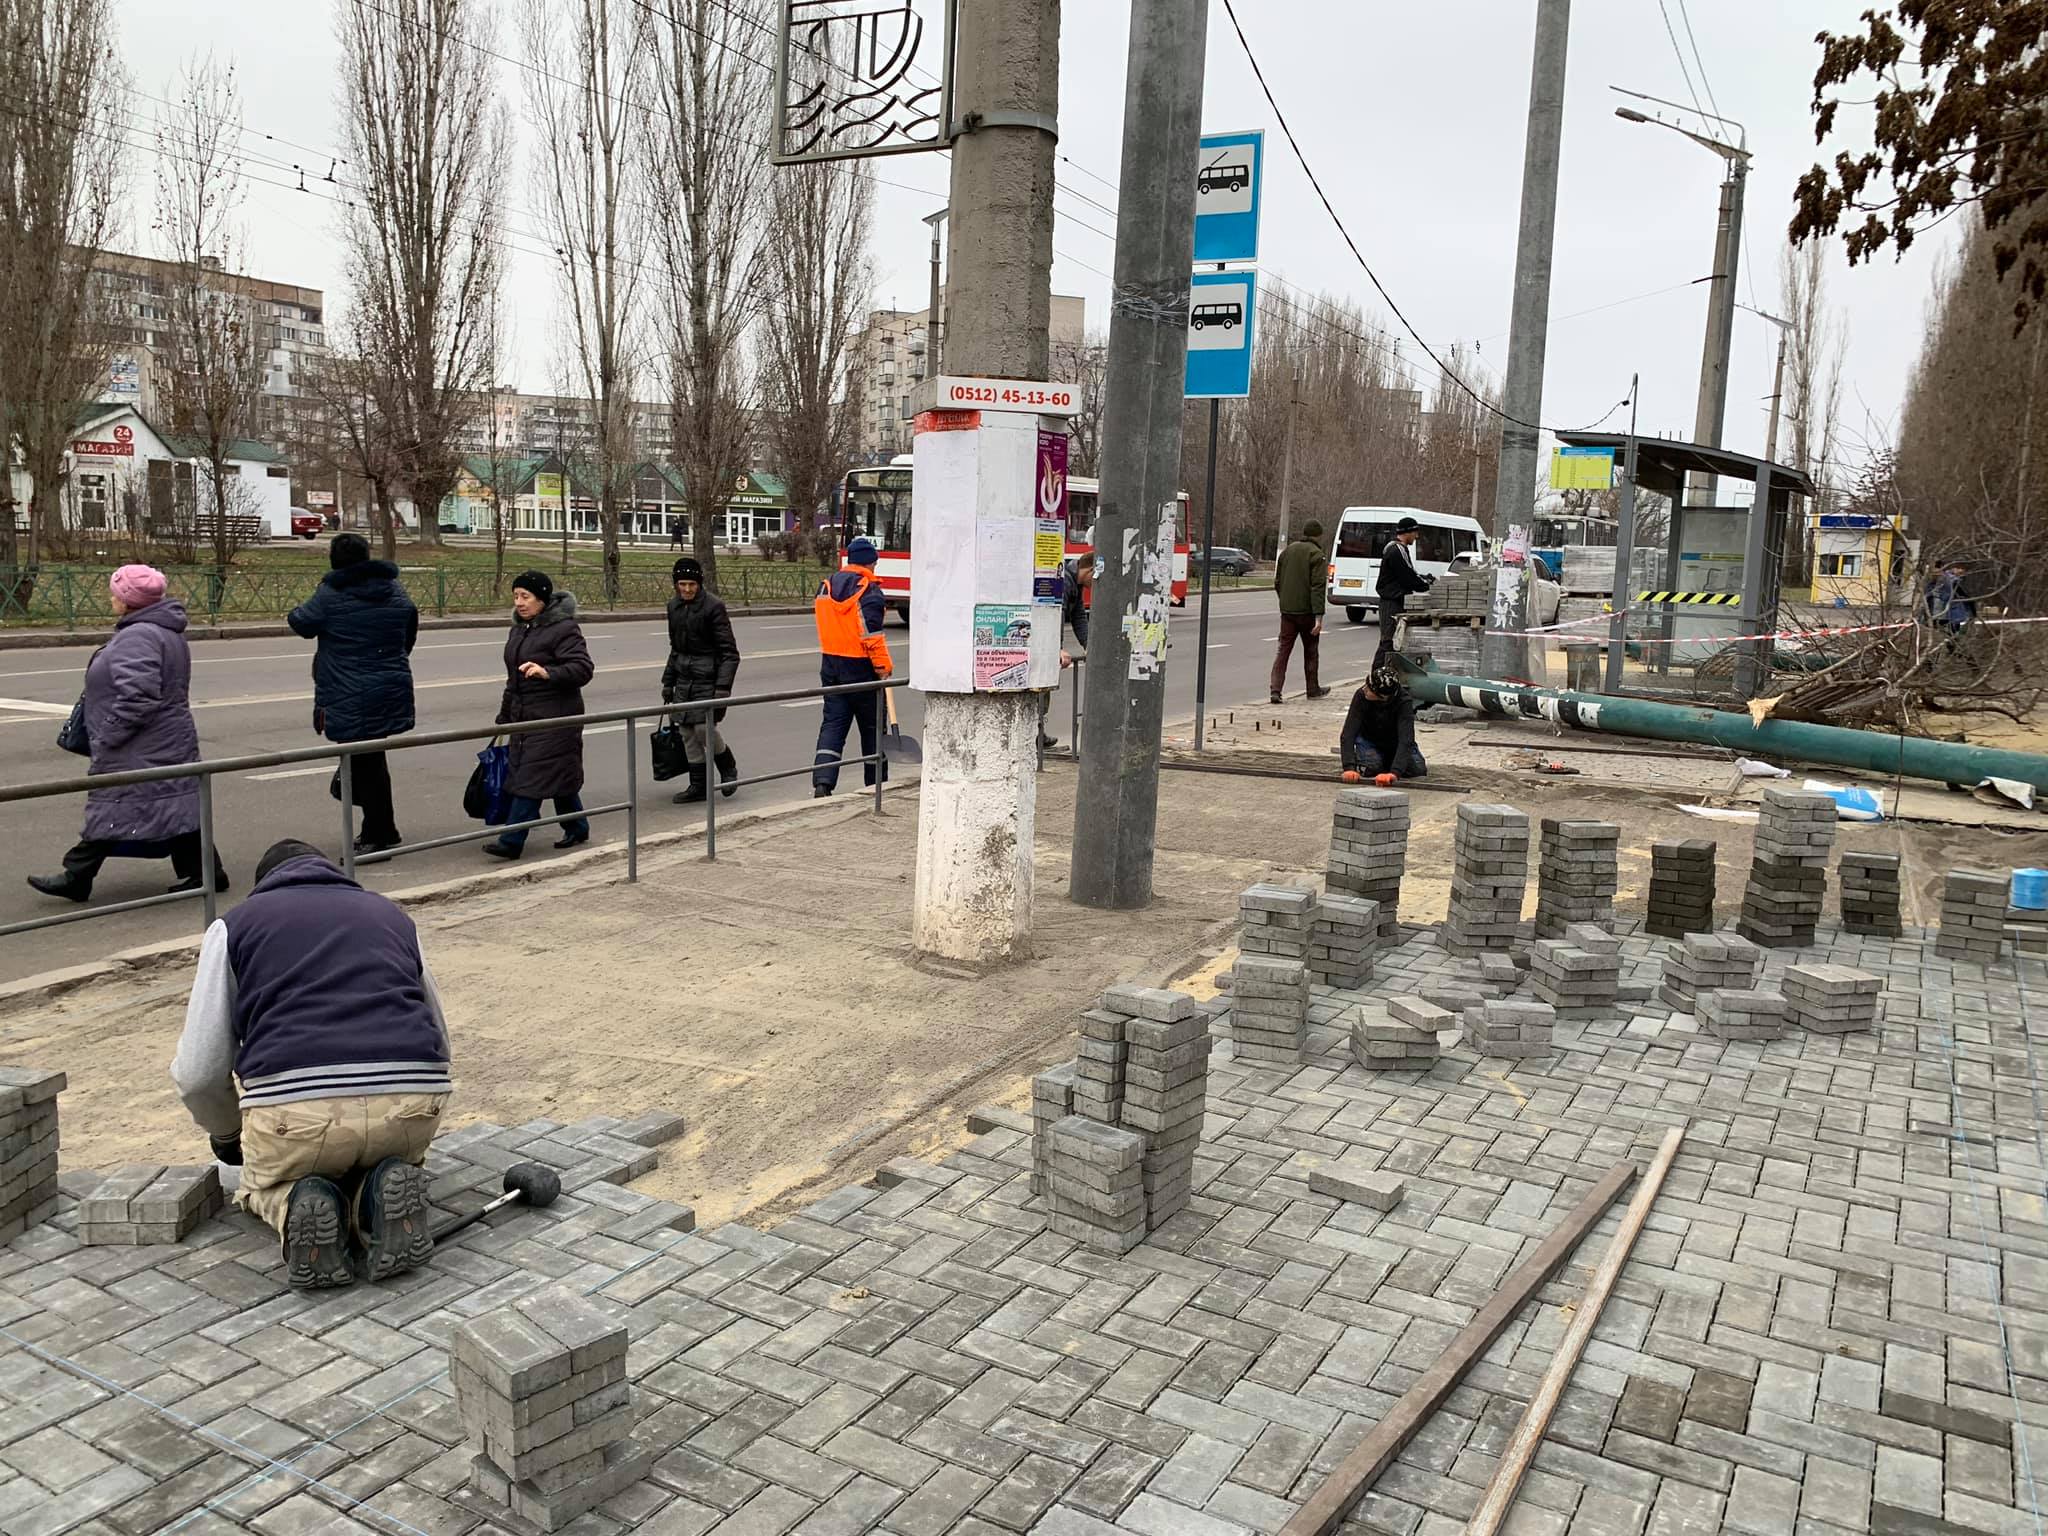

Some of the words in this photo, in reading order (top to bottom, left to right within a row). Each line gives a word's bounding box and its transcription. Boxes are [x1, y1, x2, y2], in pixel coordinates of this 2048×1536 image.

[950, 386, 998, 403] (0512)
[1001, 389, 1071, 406] 45-13-60
[115, 427, 130, 437] 24
[77, 443, 133, 454] МАГАЗИН
[742, 495, 773, 505] МАГАЗИН
[976, 615, 1007, 624] ОНЛАЙН
